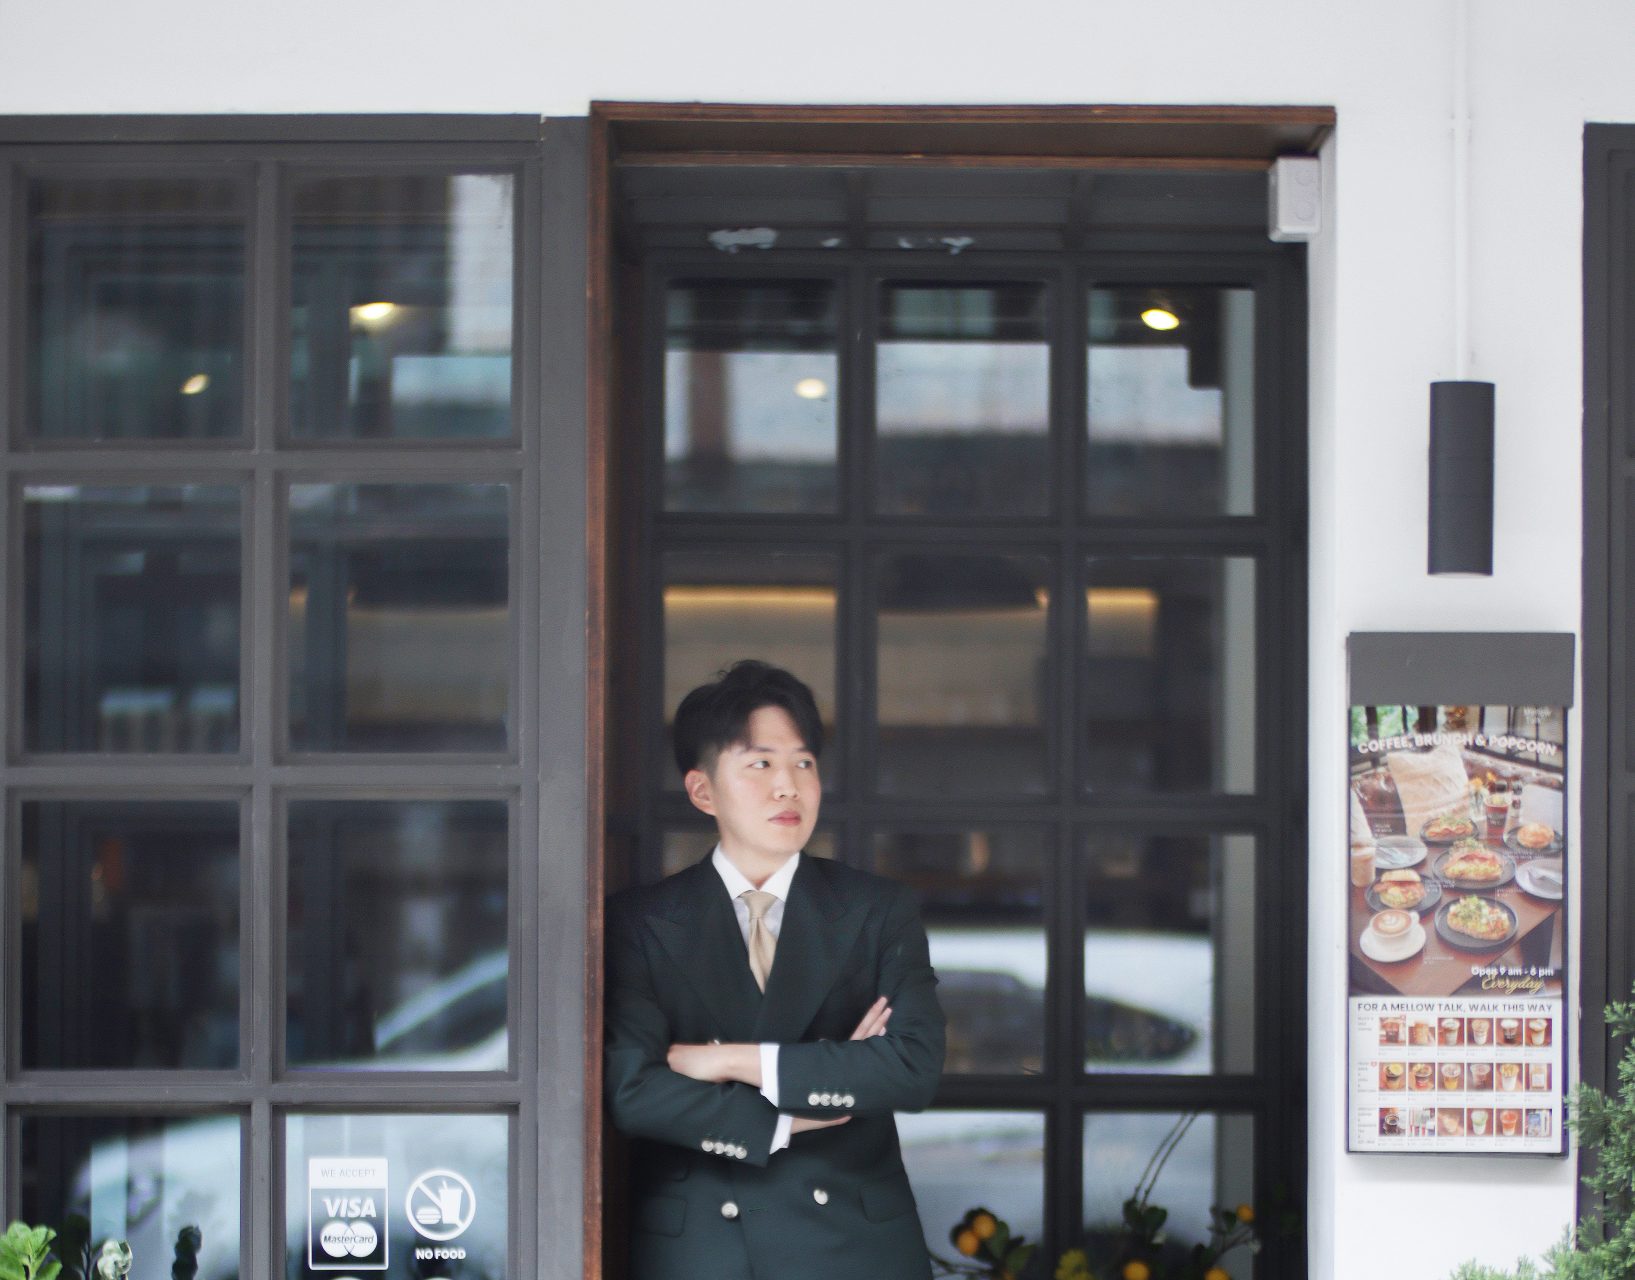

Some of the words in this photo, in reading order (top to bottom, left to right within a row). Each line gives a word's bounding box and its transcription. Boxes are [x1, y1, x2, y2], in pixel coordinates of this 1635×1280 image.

[1358, 735, 1414, 754] COFFEE,
[1415, 732, 1472, 747] BRUNCH
[1475, 735, 1487, 747] &
[1489, 734, 1557, 756] POPCORN
[1471, 966, 1498, 978] Open
[1499, 966, 1506, 977] 9
[1508, 967, 1522, 976] am
[1538, 967, 1554, 978] pm
[1482, 974, 1543, 995] Everyday
[1358, 1003, 1378, 1012] FOR
[1380, 1003, 1388, 1012] A
[1391, 1003, 1435, 1012] MELLOW
[1437, 1003, 1465, 1014] TALK,
[1469, 1003, 1498, 1012] WALK
[1502, 1003, 1525, 1012] THIS
[1527, 1003, 1553, 1012] WAY
[321, 1167, 336, 1178] WE
[339, 1167, 377, 1178] ACCEPT
[322, 1197, 377, 1218] VISA
[323, 1233, 375, 1245] MasterCard
[416, 1248, 433, 1260] NO
[434, 1248, 466, 1260] FOOD
